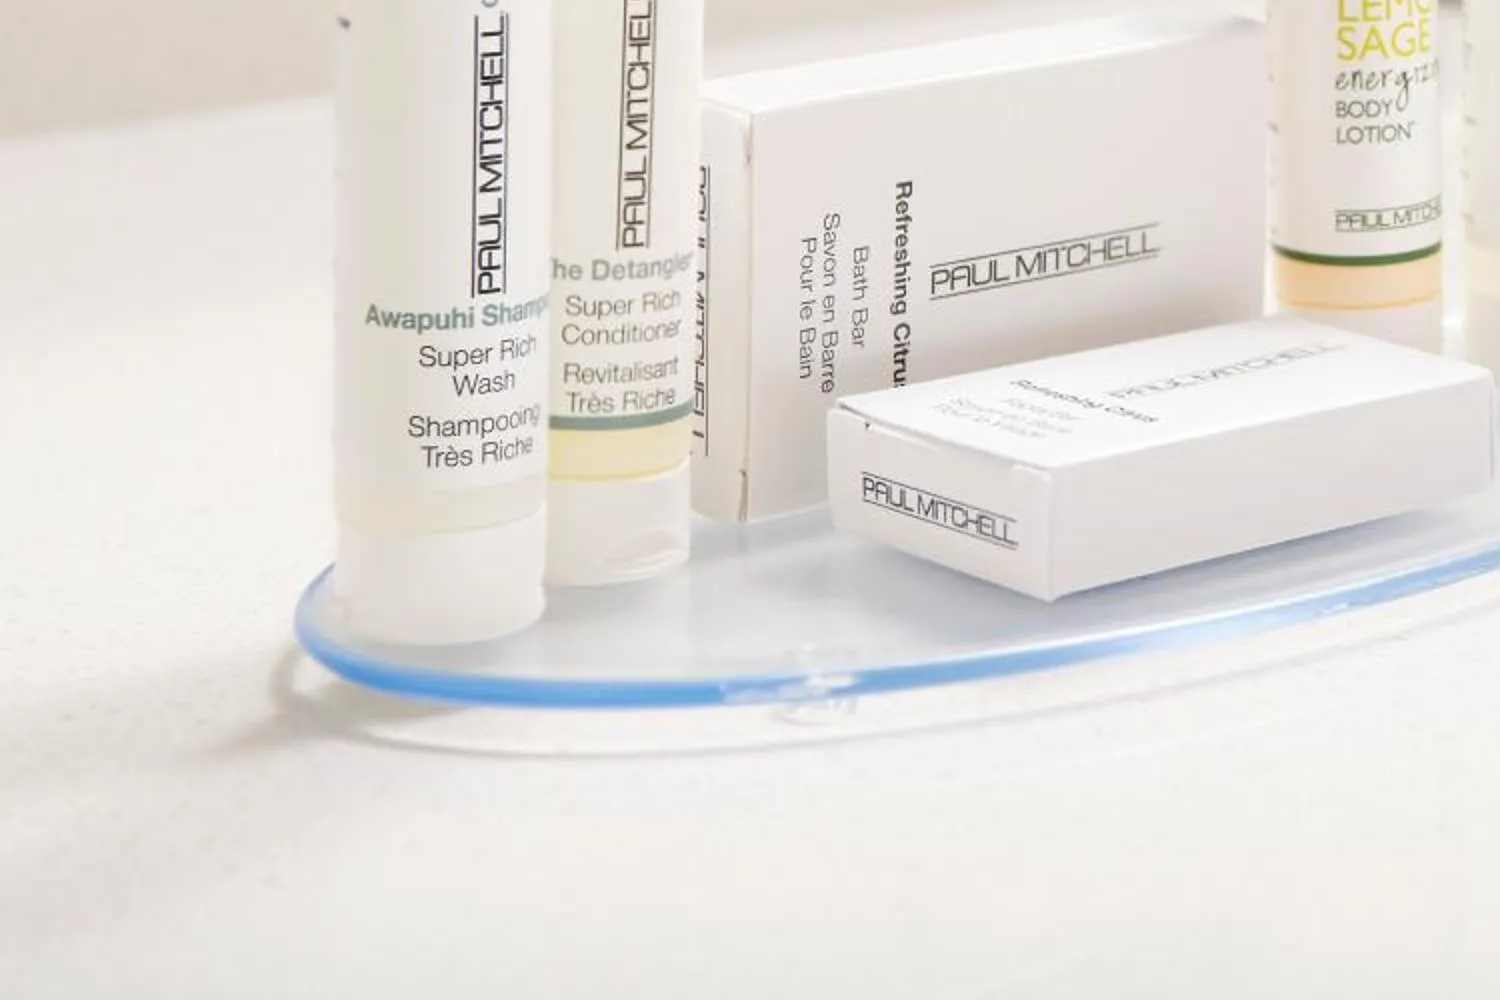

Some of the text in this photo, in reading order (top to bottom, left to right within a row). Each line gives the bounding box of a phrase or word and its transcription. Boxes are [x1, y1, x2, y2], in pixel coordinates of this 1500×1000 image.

[1337, 19, 1431, 61] SAGE
[1336, 98, 1392, 119] BODY
[477, 14, 506, 295] PAUL MITCHELL
[621, 155, 649, 250] PAUL
[1335, 211, 1388, 229] PAUL
[890, 180, 913, 316] Refreshing
[930, 230, 1162, 295] PAUL MITCHELL
[551, 257, 583, 281] he
[565, 289, 681, 321] Super Rich
[799, 237, 817, 380] Pour le Bain
[821, 212, 841, 394] Savon en Barre
[851, 245, 870, 349] Bath Bar
[365, 303, 474, 335] Awapuhi
[561, 319, 682, 346] Conditioner
[418, 334, 537, 372] Super Rich
[563, 355, 679, 385] Revitalisant
[452, 369, 516, 398] Wash
[566, 388, 676, 414] Très Riche
[408, 402, 541, 439] Shampooing
[421, 435, 534, 469] Très Riche
[862, 476, 1020, 546] PAUL MITCHELL
